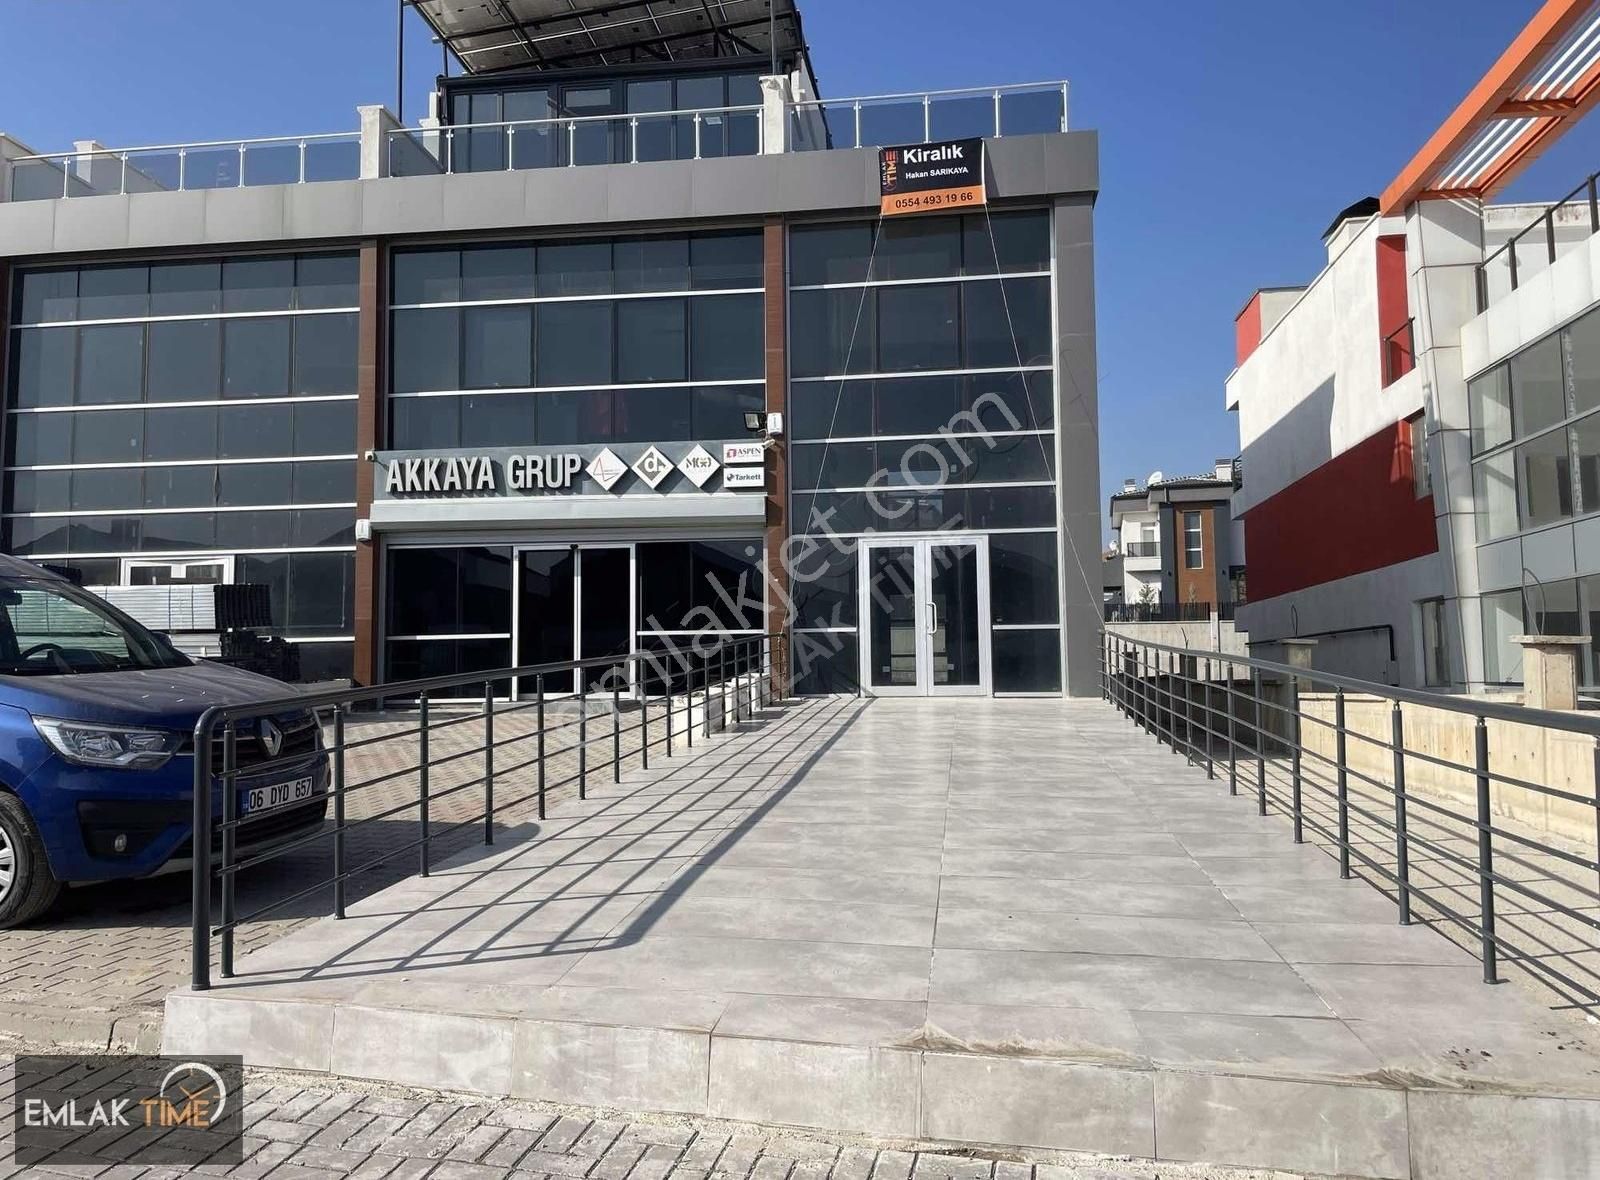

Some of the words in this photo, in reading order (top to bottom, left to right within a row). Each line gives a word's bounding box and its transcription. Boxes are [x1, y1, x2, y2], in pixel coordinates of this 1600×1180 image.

[903, 144, 964, 164] Kiralık
[905, 170, 929, 180] Hakan
[929, 166, 969, 177] SARIKAYA
[895, 197, 920, 208] 0554
[923, 195, 941, 205] 493
[945, 194, 957, 203] 19
[960, 191, 973, 201] 66
[737, 447, 761, 455] ASPEN
[385, 456, 496, 493] AKKAYA
[506, 453, 582, 490] GRUP
[249, 790, 264, 809] 06
[270, 784, 290, 805] DYD
[295, 780, 312, 798] 657
